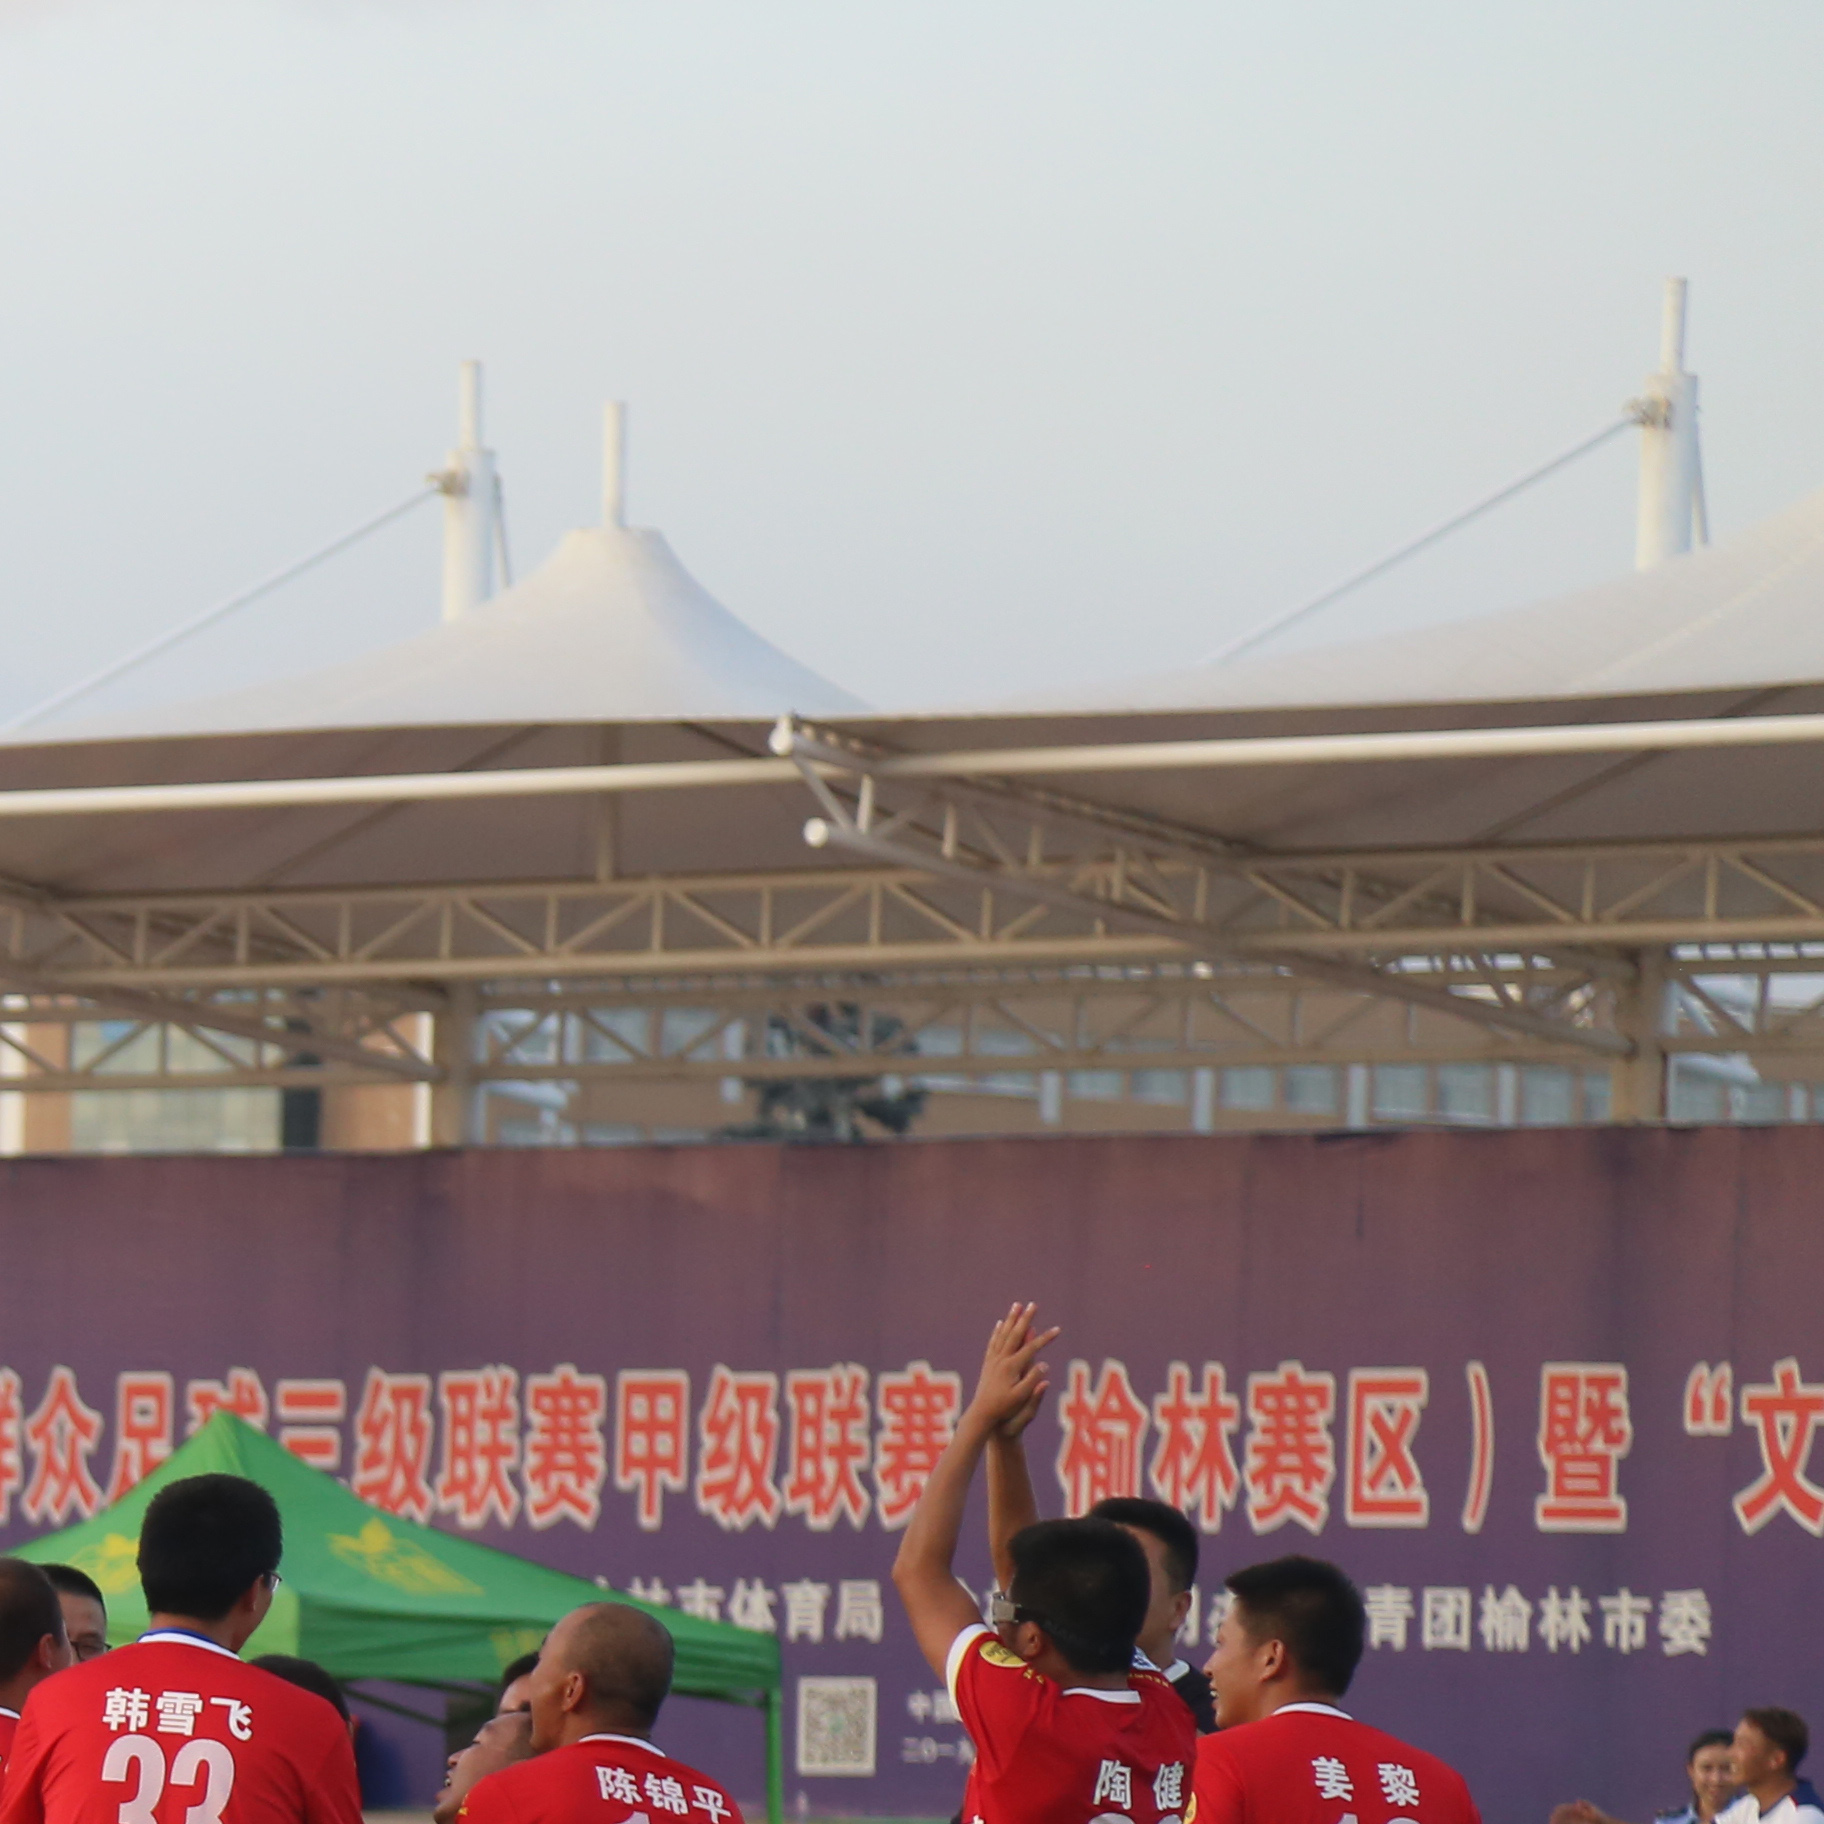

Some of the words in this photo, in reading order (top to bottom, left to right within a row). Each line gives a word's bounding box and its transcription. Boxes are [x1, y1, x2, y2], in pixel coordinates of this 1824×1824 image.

[102, 1687, 253, 1742] 韩雪飞
[595, 1765, 732, 1824] 陈锦平
